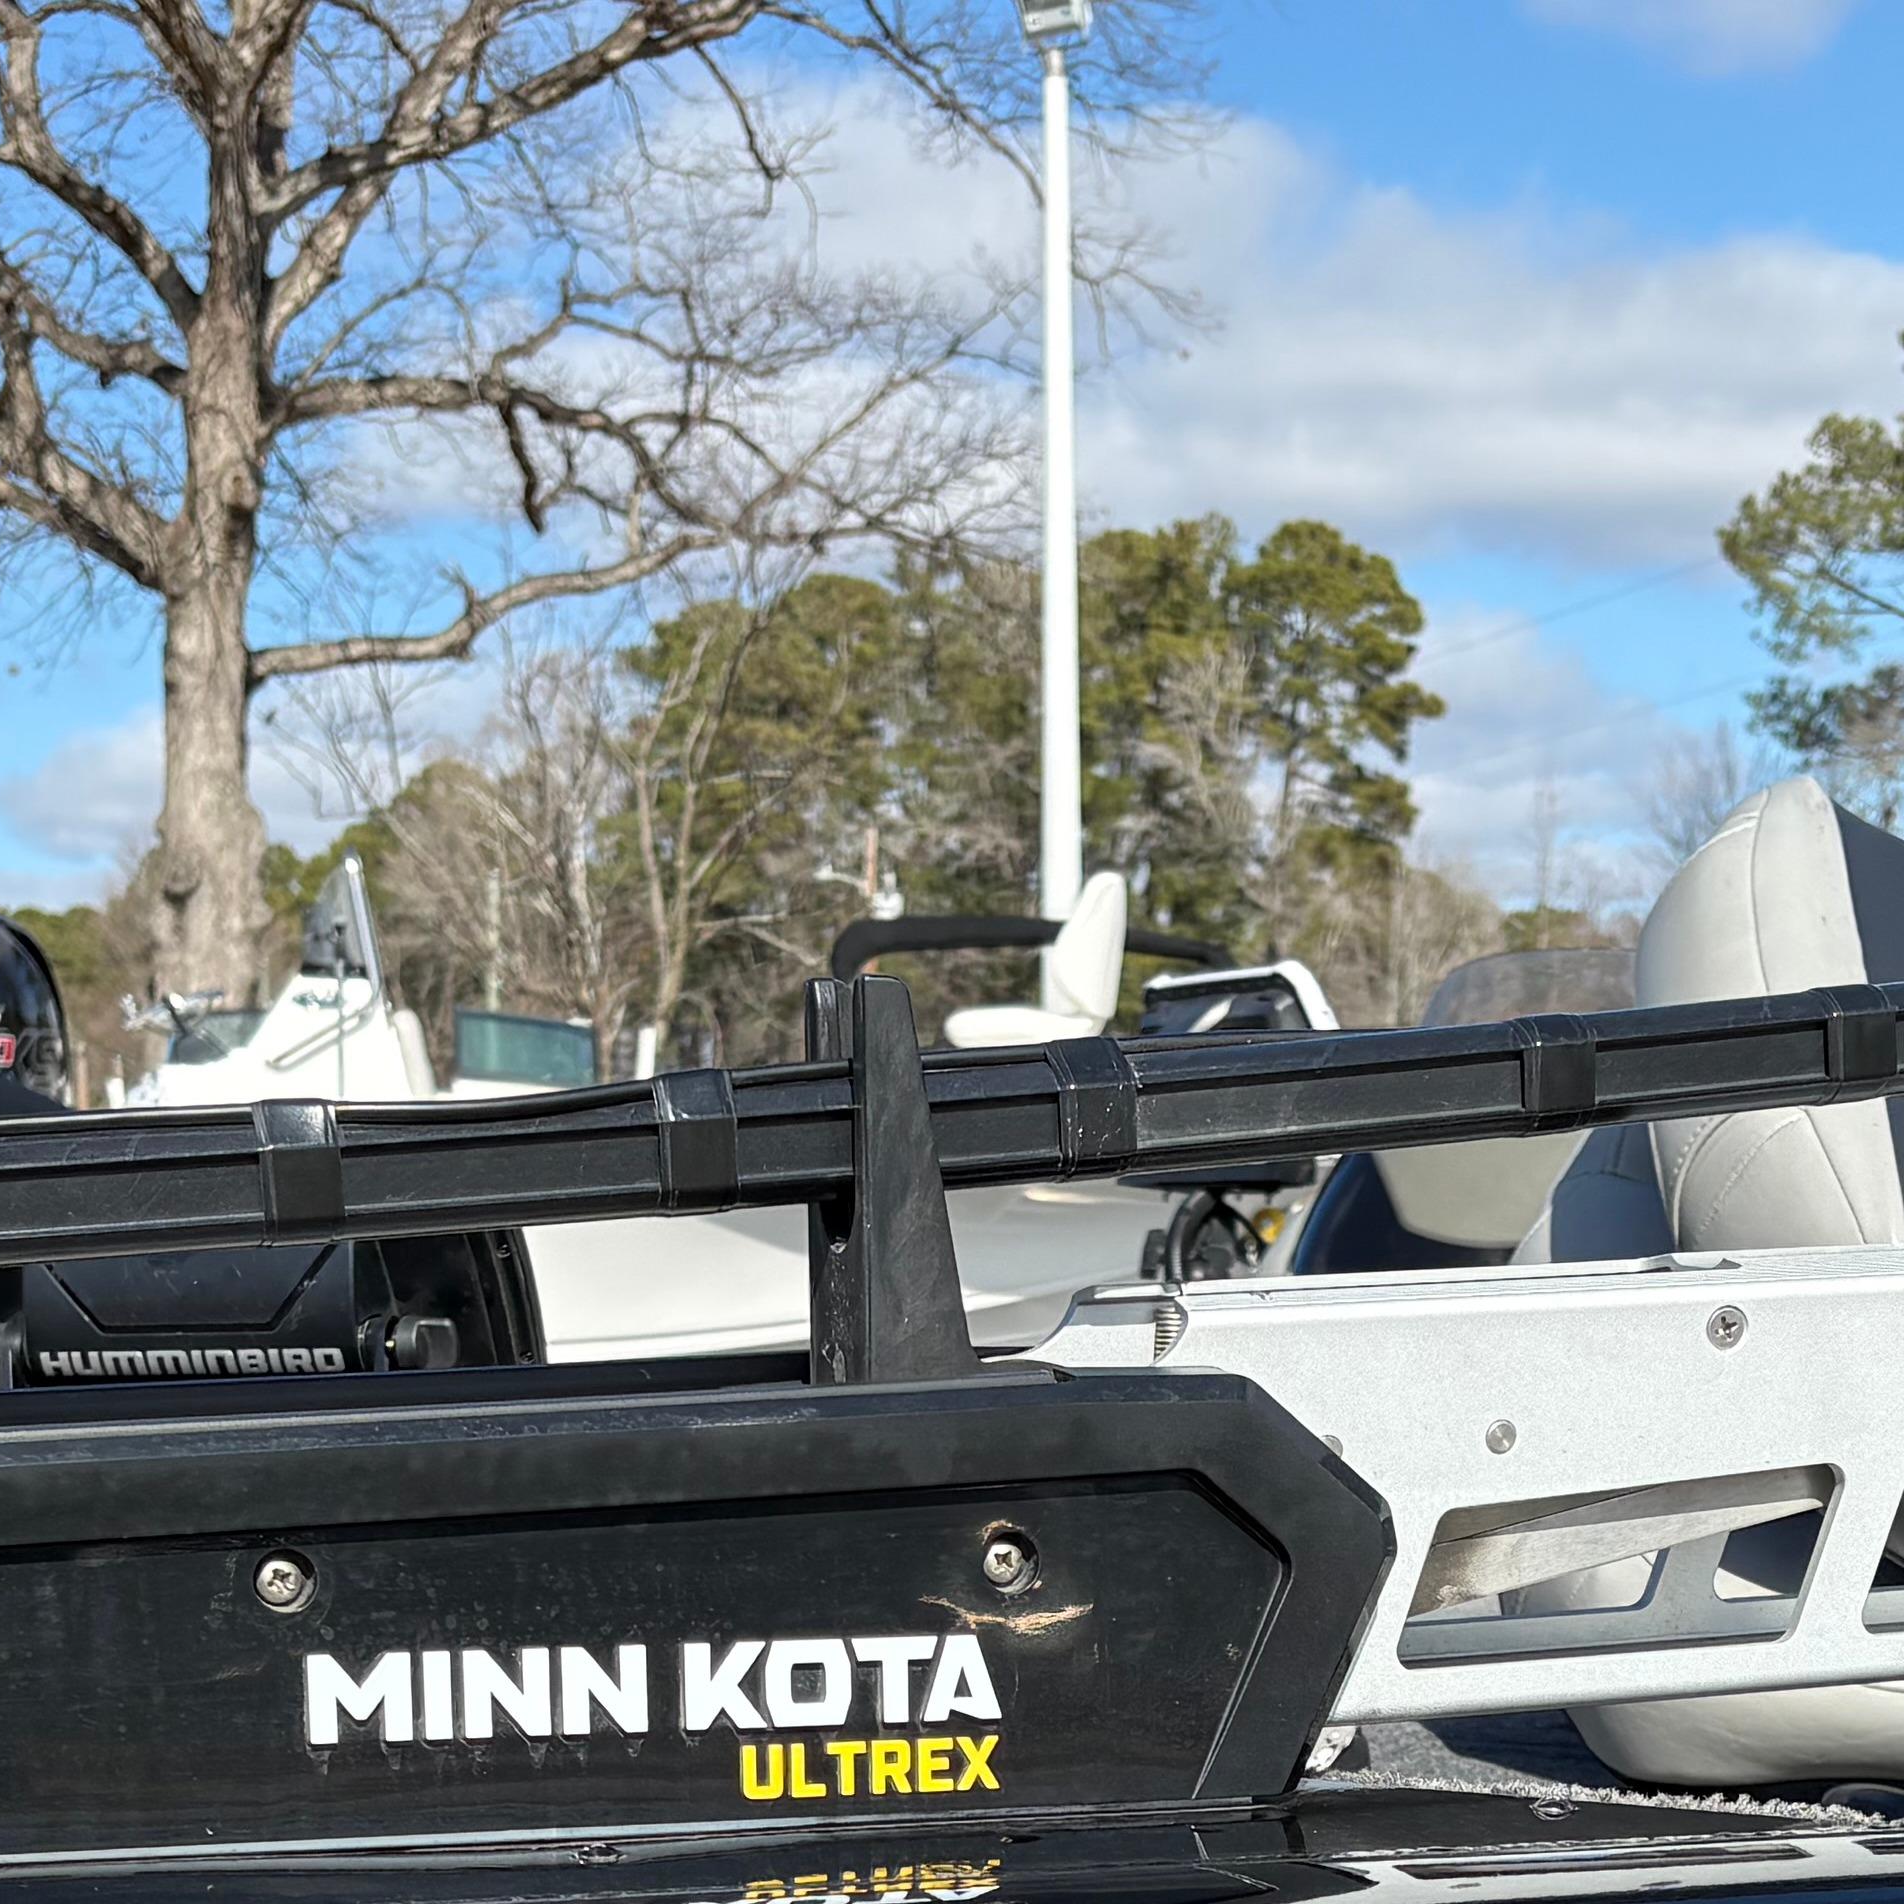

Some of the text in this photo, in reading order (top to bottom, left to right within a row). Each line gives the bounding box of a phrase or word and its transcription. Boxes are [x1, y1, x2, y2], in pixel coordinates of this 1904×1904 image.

[39, 1347, 346, 1377] HUMMINBIRD
[306, 1634, 1002, 1746] MINN KOTA
[739, 1735, 1002, 1800] ULTREX
